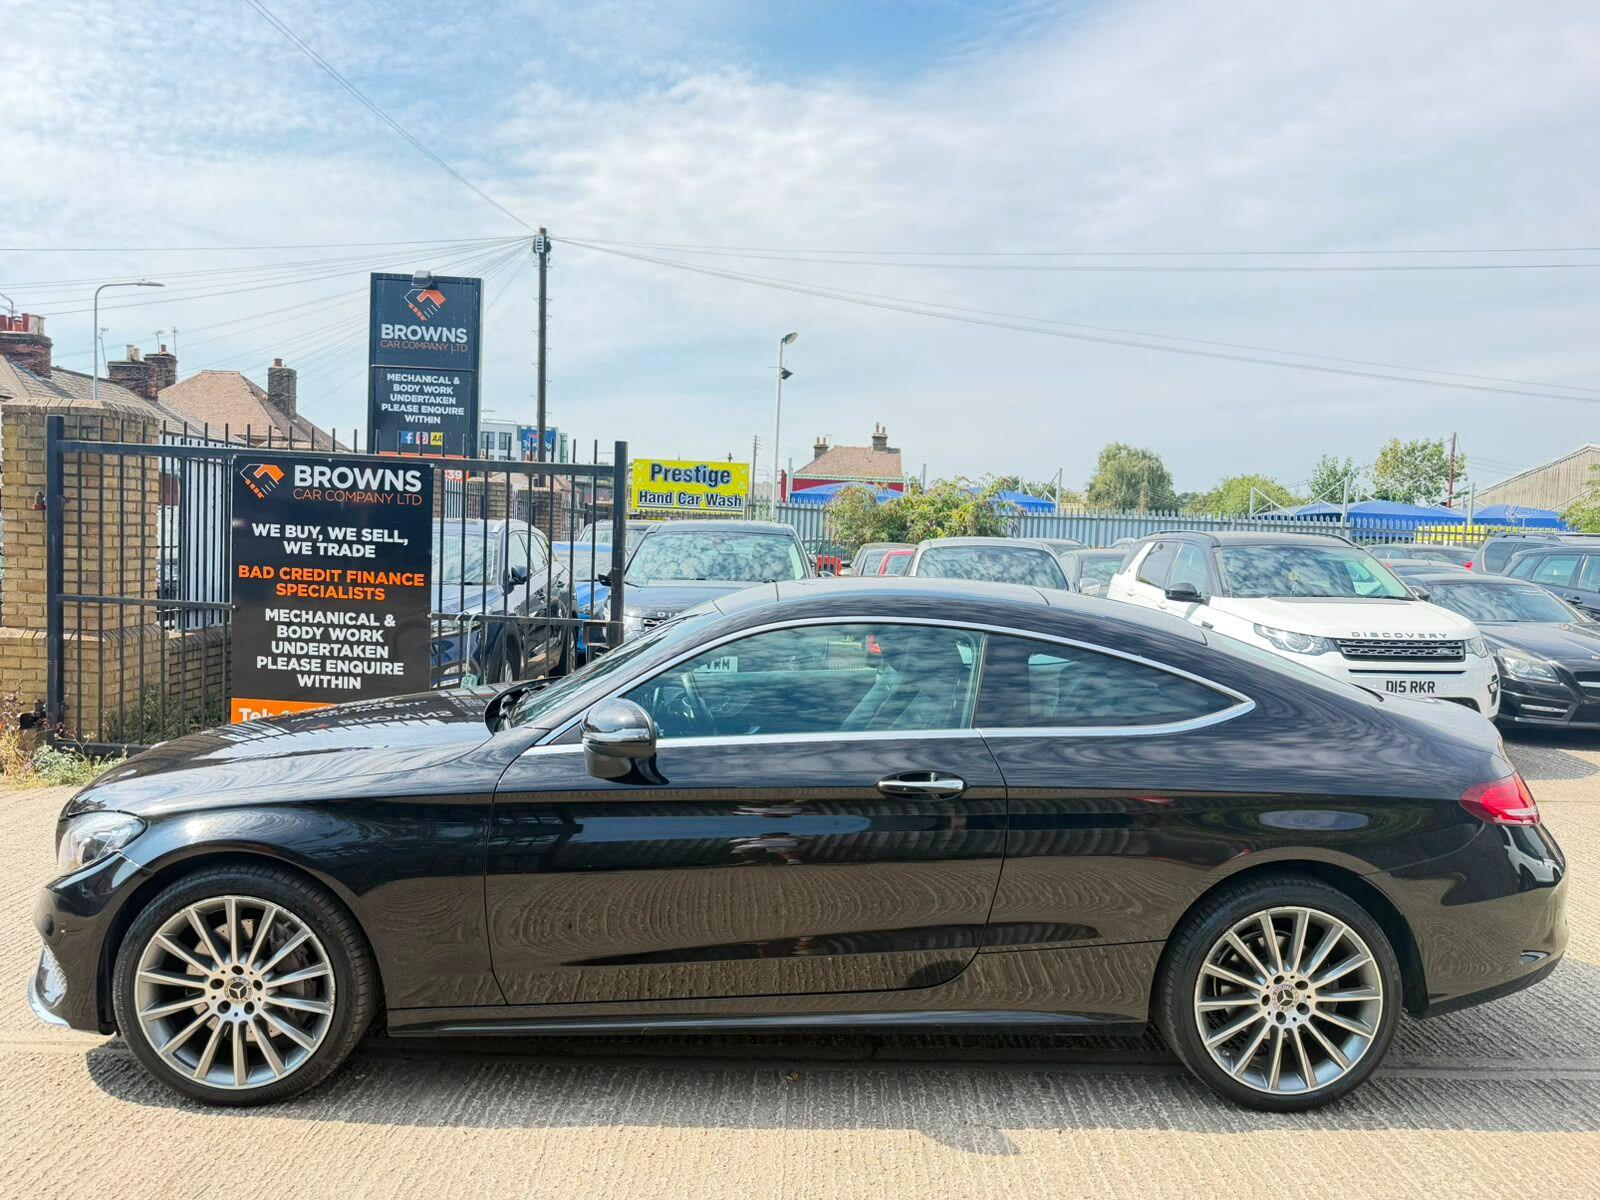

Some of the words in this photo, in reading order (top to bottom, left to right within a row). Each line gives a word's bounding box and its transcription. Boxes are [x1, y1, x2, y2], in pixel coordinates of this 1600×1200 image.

[381, 324, 468, 343] BROWNS
[381, 340, 400, 348] CAR
[402, 341, 448, 351] COMPANY
[451, 344, 468, 352] LTD
[387, 373, 451, 384] MECHANICAL
[453, 377, 460, 385] &
[393, 384, 420, 392] BODY
[423, 386, 453, 394] WORK
[390, 394, 456, 404] UNDERTAKEN
[382, 403, 419, 413] PLEASE
[422, 405, 464, 415] ENQUIRE
[405, 415, 441, 424] WITHIN
[294, 465, 421, 492] BROWNS
[651, 463, 731, 488] Prestige
[293, 489, 321, 500] CAR
[325, 490, 393, 504] COMPANY
[397, 494, 422, 505] LTD
[639, 491, 672, 504] Hand
[678, 492, 701, 505] Car
[706, 494, 742, 507] Wash
[252, 523, 280, 536] WE
[285, 525, 323, 541] BUY,
[328, 527, 357, 540] WE
[361, 528, 408, 545] SELL,
[284, 541, 312, 554] WE
[316, 543, 375, 558] TRADE
[239, 565, 274, 578] BAD
[279, 567, 341, 582] CREDIT
[347, 571, 424, 586] FINANCE
[276, 584, 385, 600] SPECIALISTS
[265, 609, 380, 626] MECHANICAL
[384, 615, 396, 627] &
[277, 625, 324, 639] BODY
[329, 628, 384, 642] WORK
[271, 642, 388, 658] UNDERTAKEN
[257, 656, 321, 672] PLEASE
[326, 660, 404, 675] ENQUIRE
[297, 674, 361, 689] WITHIN
[1410, 681, 1435, 693] RKR
